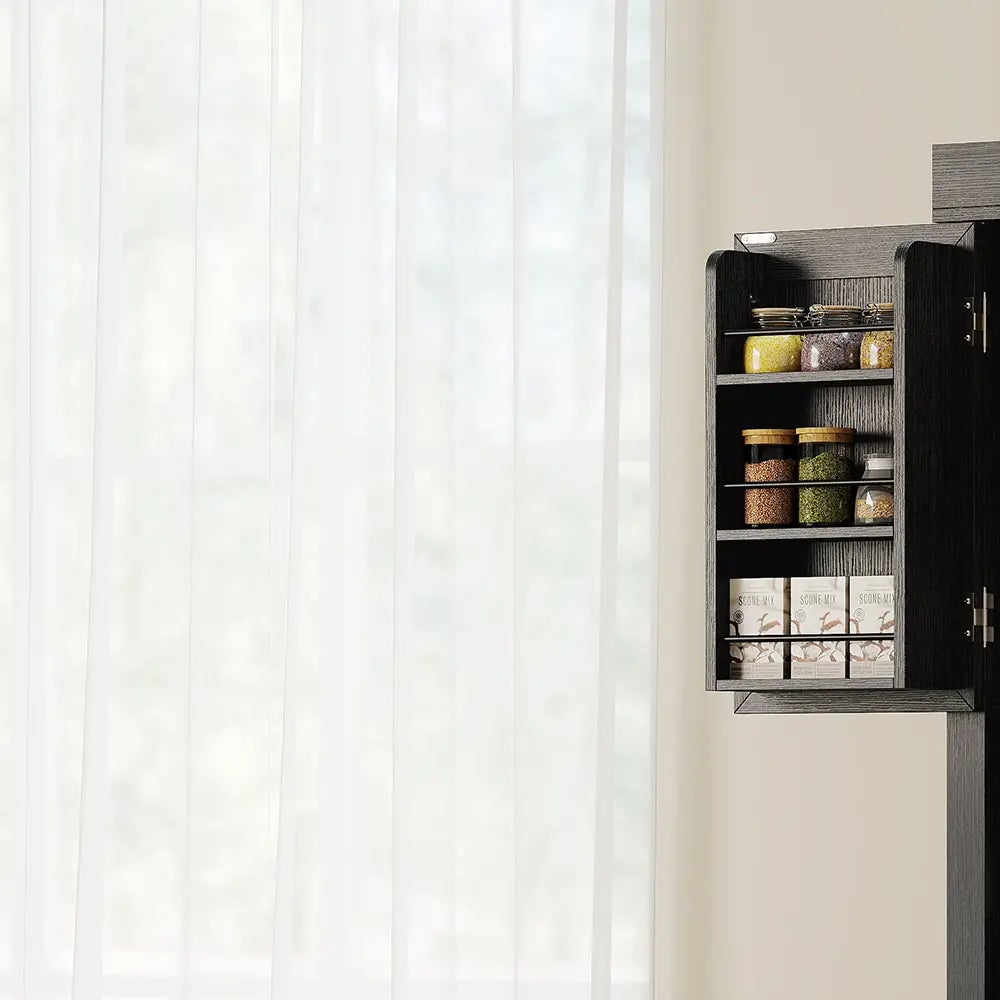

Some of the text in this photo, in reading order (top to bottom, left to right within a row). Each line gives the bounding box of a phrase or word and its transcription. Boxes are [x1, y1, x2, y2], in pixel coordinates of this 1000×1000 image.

[738, 594, 775, 607] SCONE MIX
[799, 593, 837, 605] SCONE MIX
[859, 592, 881, 605] SCONE
